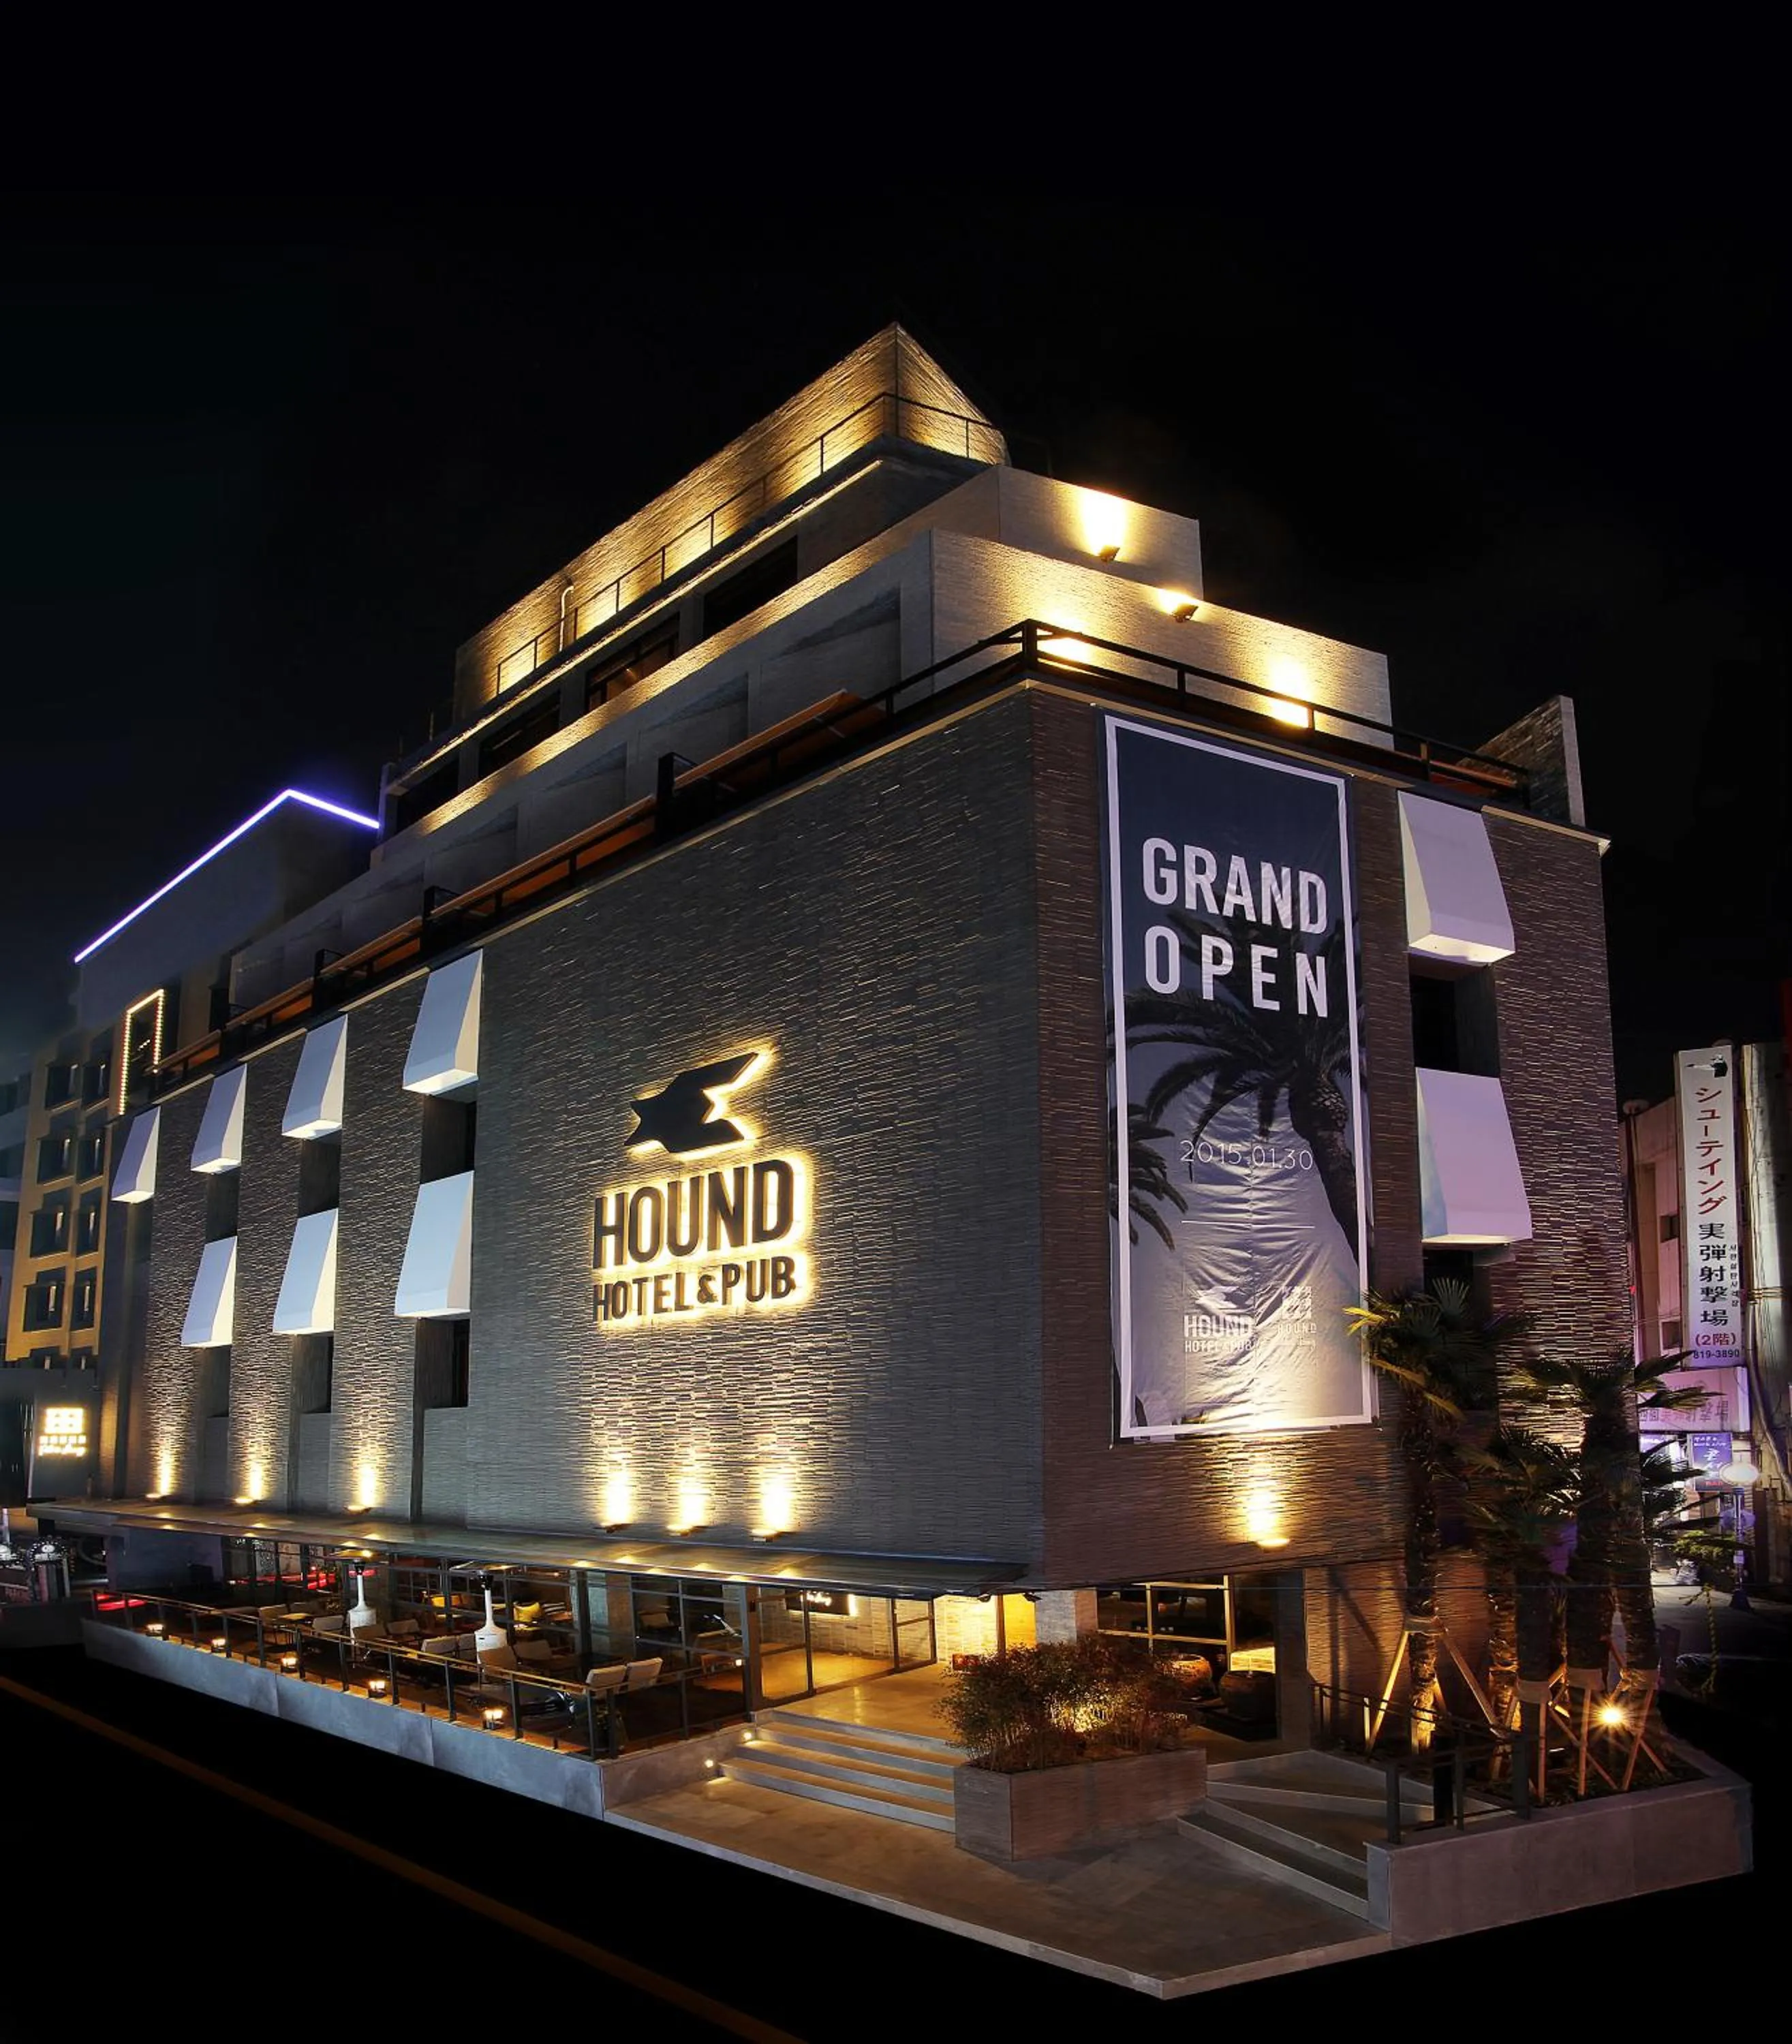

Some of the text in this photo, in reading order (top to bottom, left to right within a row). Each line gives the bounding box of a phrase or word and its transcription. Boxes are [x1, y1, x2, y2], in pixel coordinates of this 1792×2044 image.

[1143, 837, 1327, 934] GRAND
[1145, 925, 1328, 1018] OPEN
[1179, 1140, 1314, 1170] 2015.01.30
[592, 1159, 795, 1269] HOUND
[1698, 1222, 1729, 1326] 実弾射撃場
[1184, 1314, 1253, 1337] HOUND
[1693, 1348, 1740, 1359] 819-3890
[1694, 1332, 1736, 1347] (2階)
